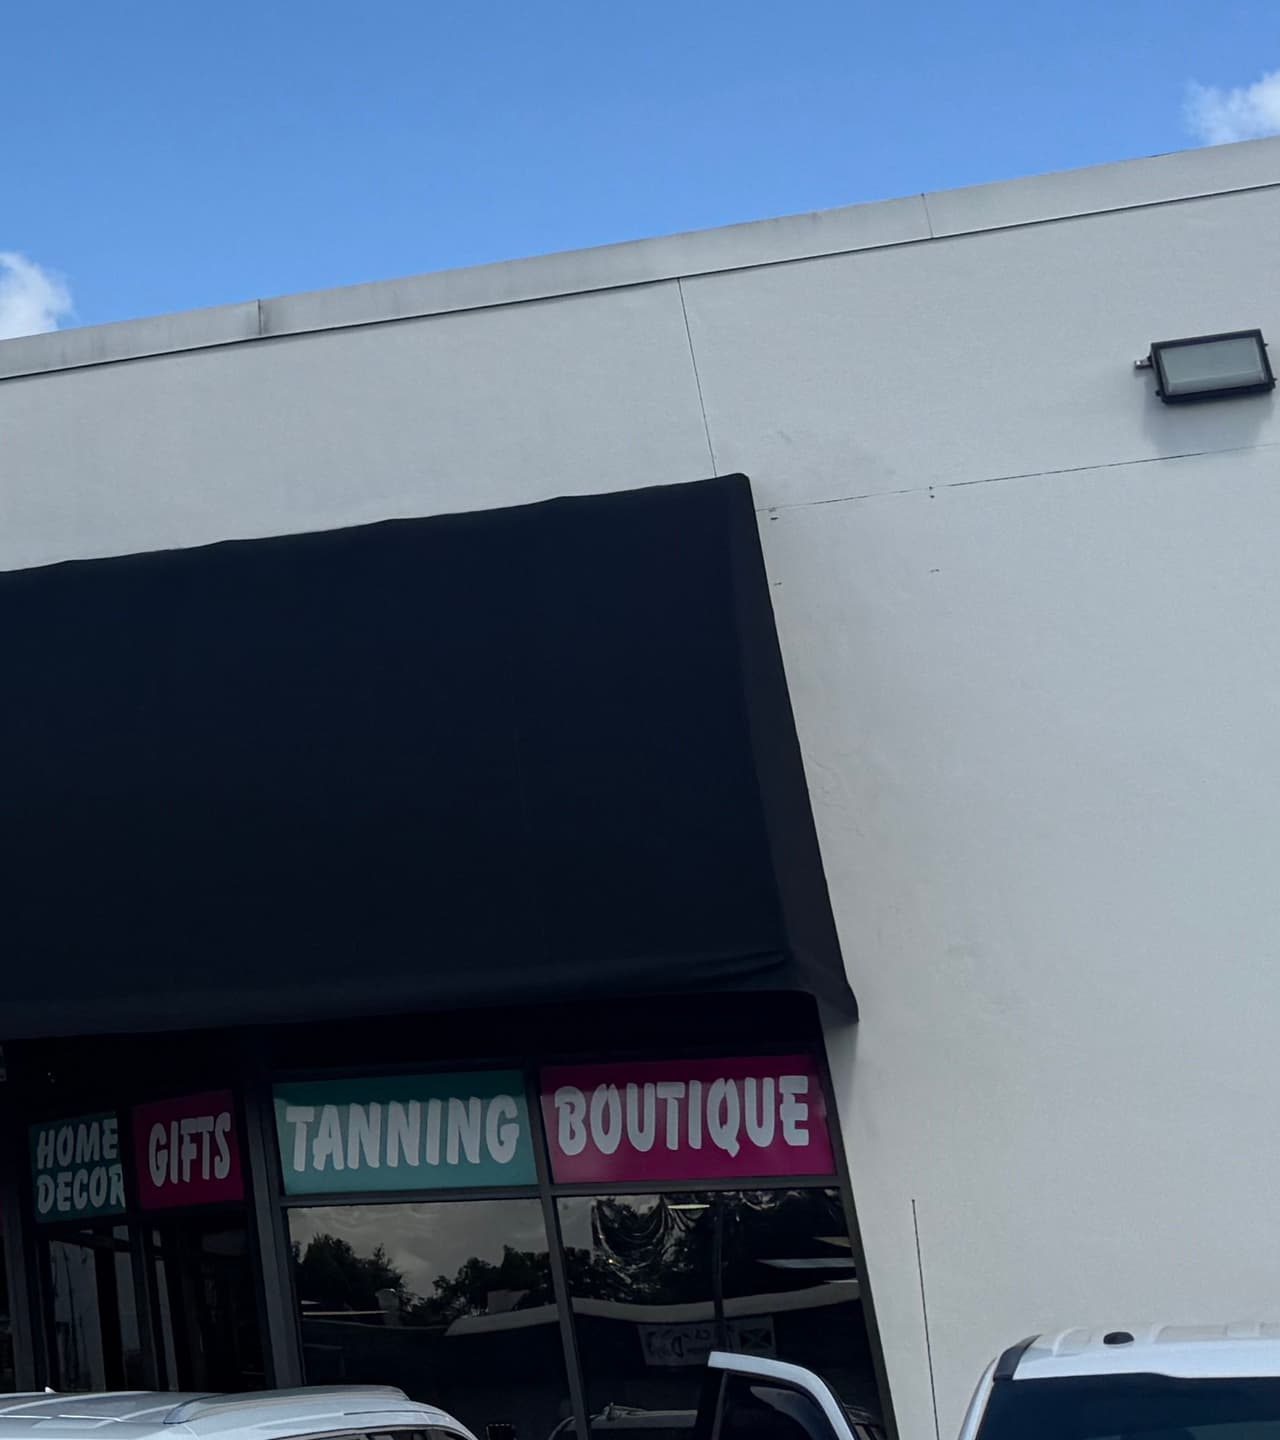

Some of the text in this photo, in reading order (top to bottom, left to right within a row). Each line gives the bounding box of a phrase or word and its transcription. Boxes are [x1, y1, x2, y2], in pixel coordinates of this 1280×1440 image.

[37, 1117, 118, 1169] HOME
[147, 1111, 232, 1188] GIFTS
[285, 1093, 521, 1173] TANNING
[554, 1074, 811, 1159] BOUTIQUE
[36, 1163, 126, 1215] DECOR
